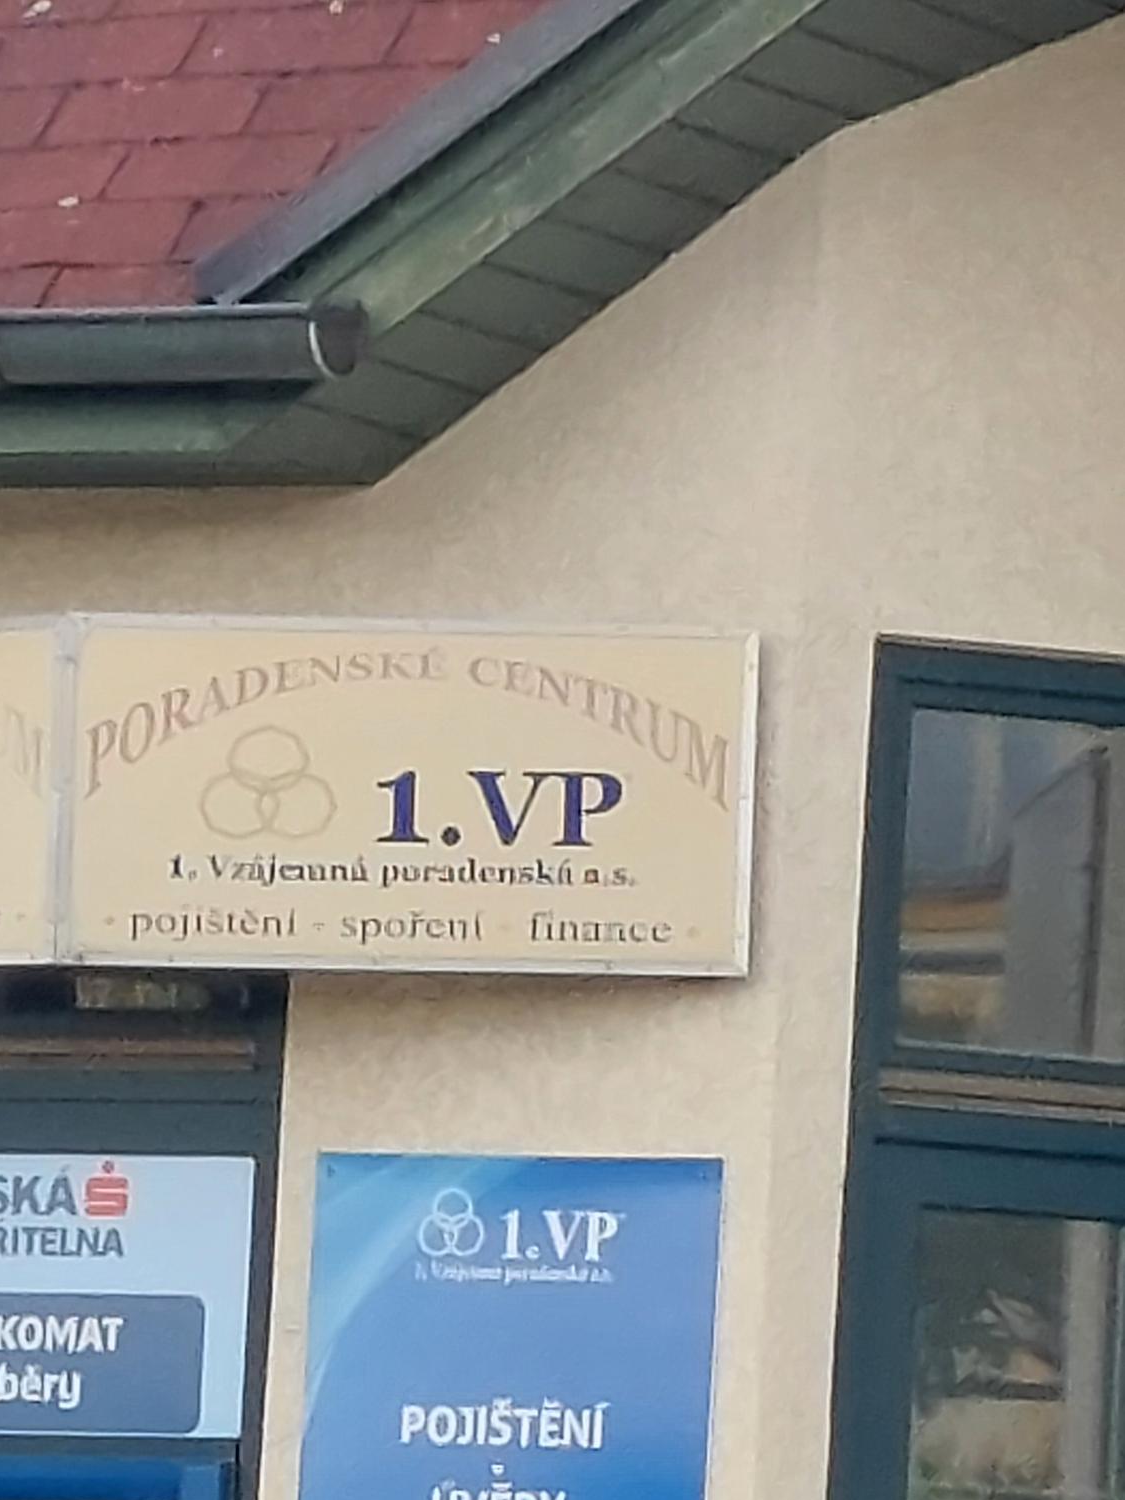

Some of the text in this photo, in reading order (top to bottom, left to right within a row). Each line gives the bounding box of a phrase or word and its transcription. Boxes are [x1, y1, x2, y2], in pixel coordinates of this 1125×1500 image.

[84, 645, 731, 810] PORADENSKÉ CENTRUM
[377, 770, 625, 847] 1.VP
[530, 908, 673, 944] finance
[499, 1209, 621, 1262] 1.VP
[399, 1396, 609, 1450] POJIŠTĚNÍ
